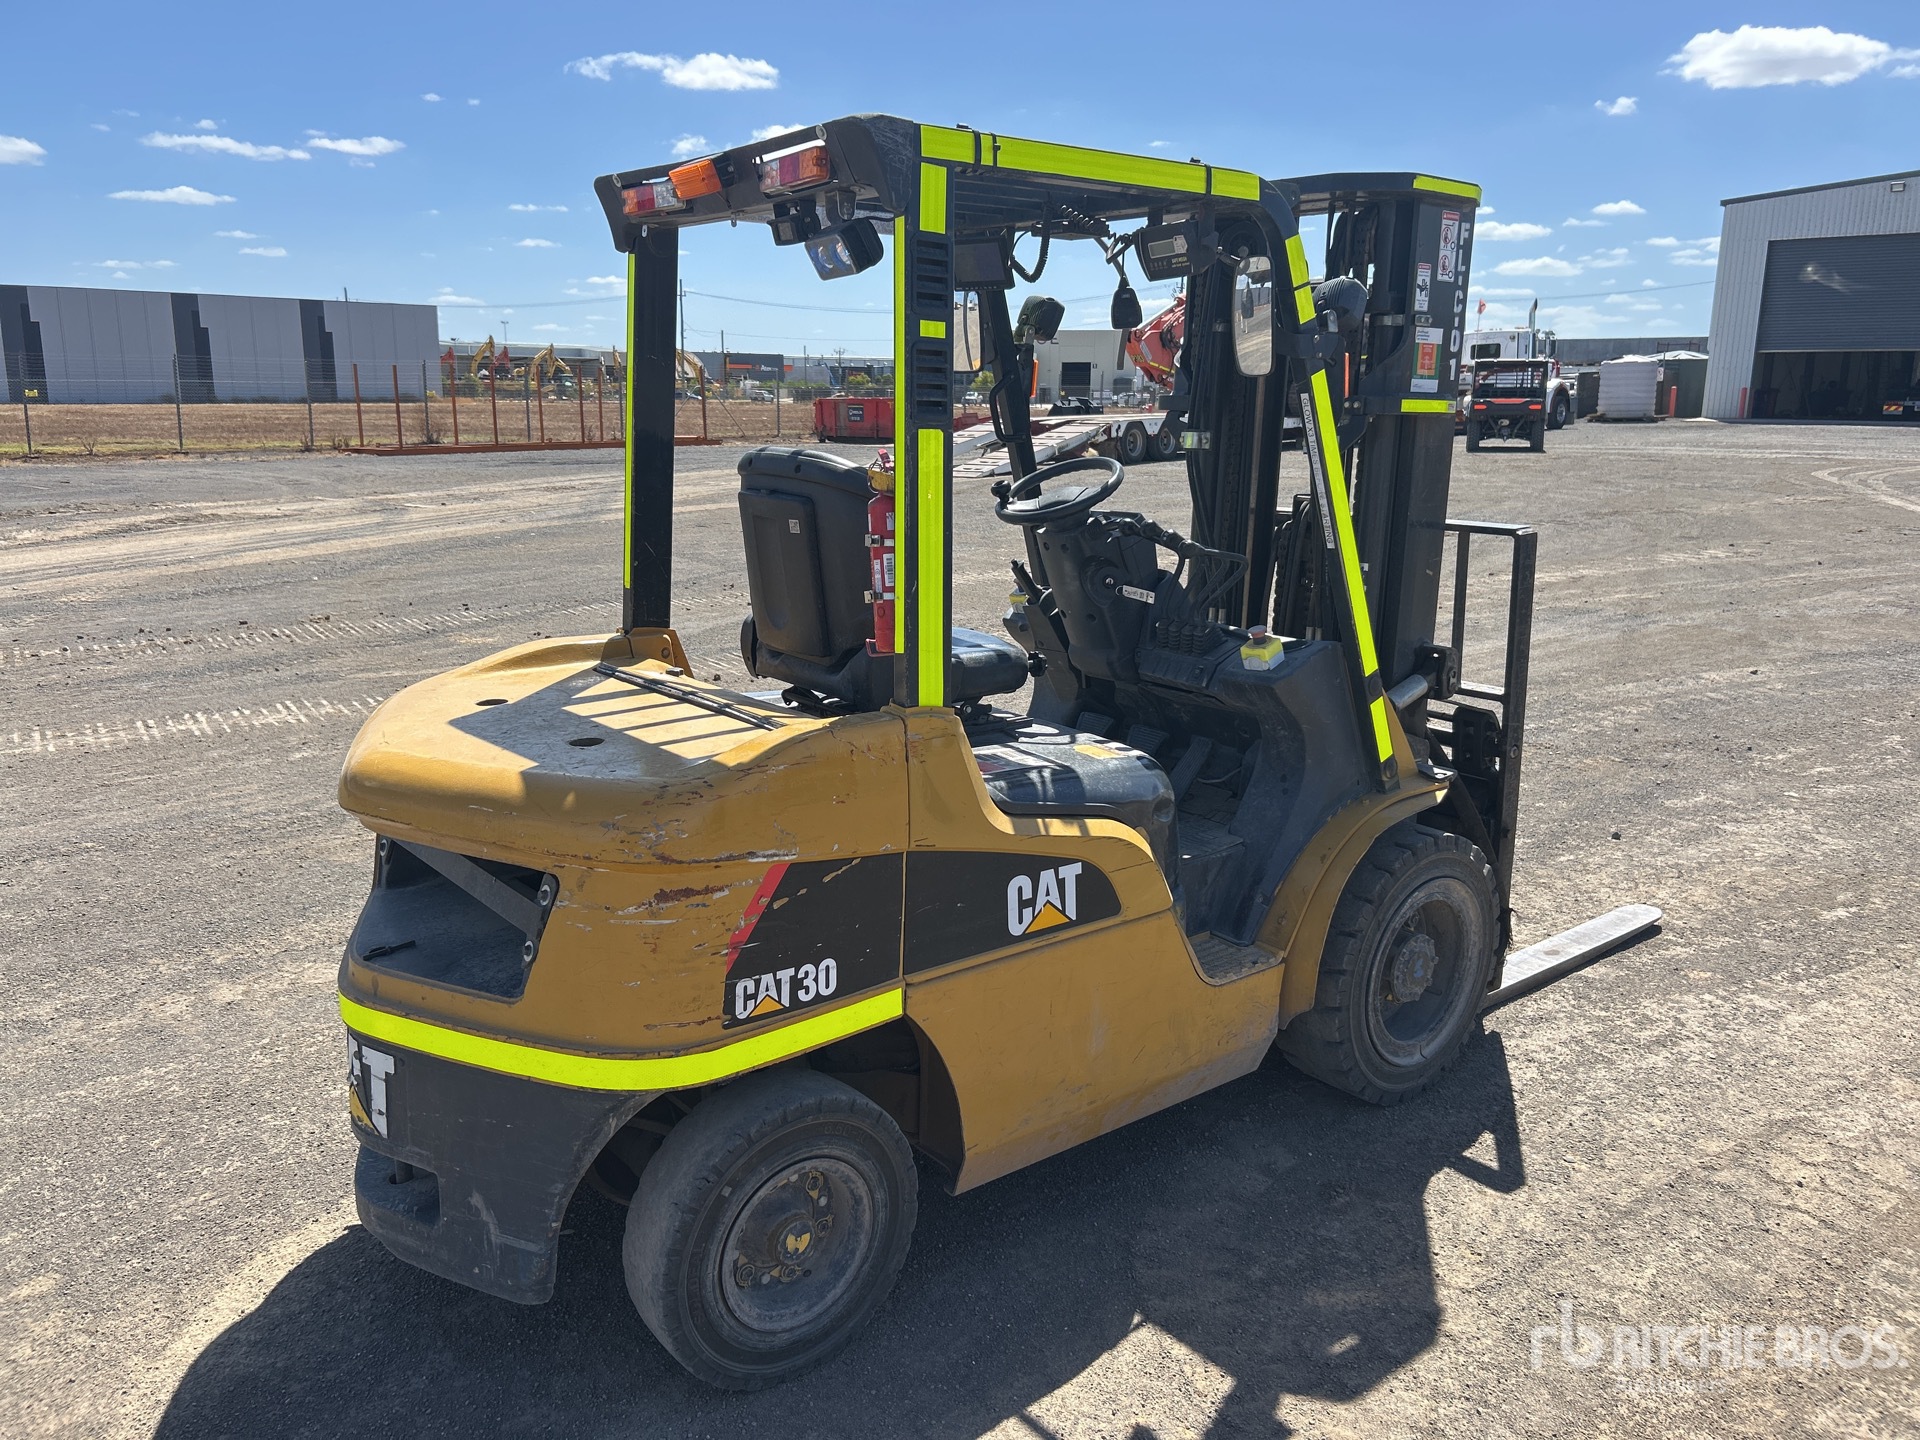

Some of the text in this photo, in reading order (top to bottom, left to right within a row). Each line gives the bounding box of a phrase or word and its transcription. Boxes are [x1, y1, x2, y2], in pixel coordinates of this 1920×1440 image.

[1302, 397, 1313, 425] GLOW
[1307, 427, 1315, 438] X3
[1309, 440, 1319, 465] TIMES
[1007, 861, 1083, 936] CAT
